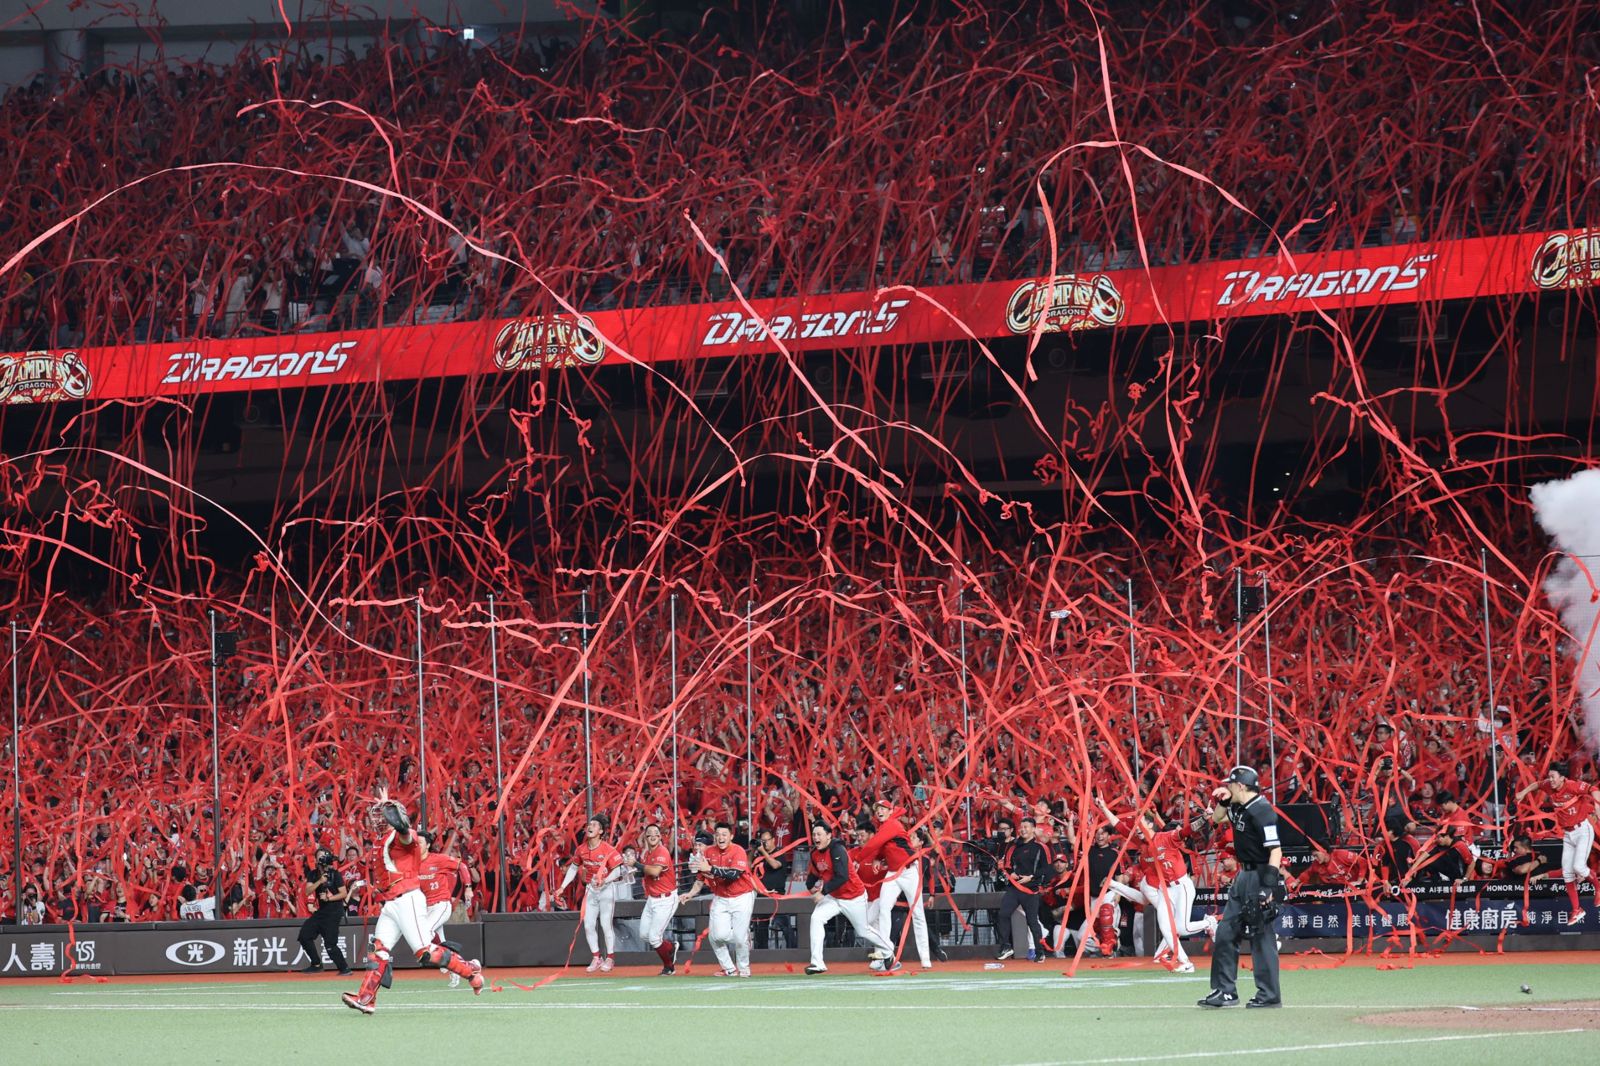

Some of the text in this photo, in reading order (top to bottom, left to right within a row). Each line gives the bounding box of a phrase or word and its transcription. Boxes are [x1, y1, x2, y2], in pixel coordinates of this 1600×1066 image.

[1281, 914, 1339, 929] 純淨自然
[1445, 907, 1518, 931] 健康廚房
[1526, 911, 1585, 924] 純淨自
[2, 942, 55, 972] 人壽
